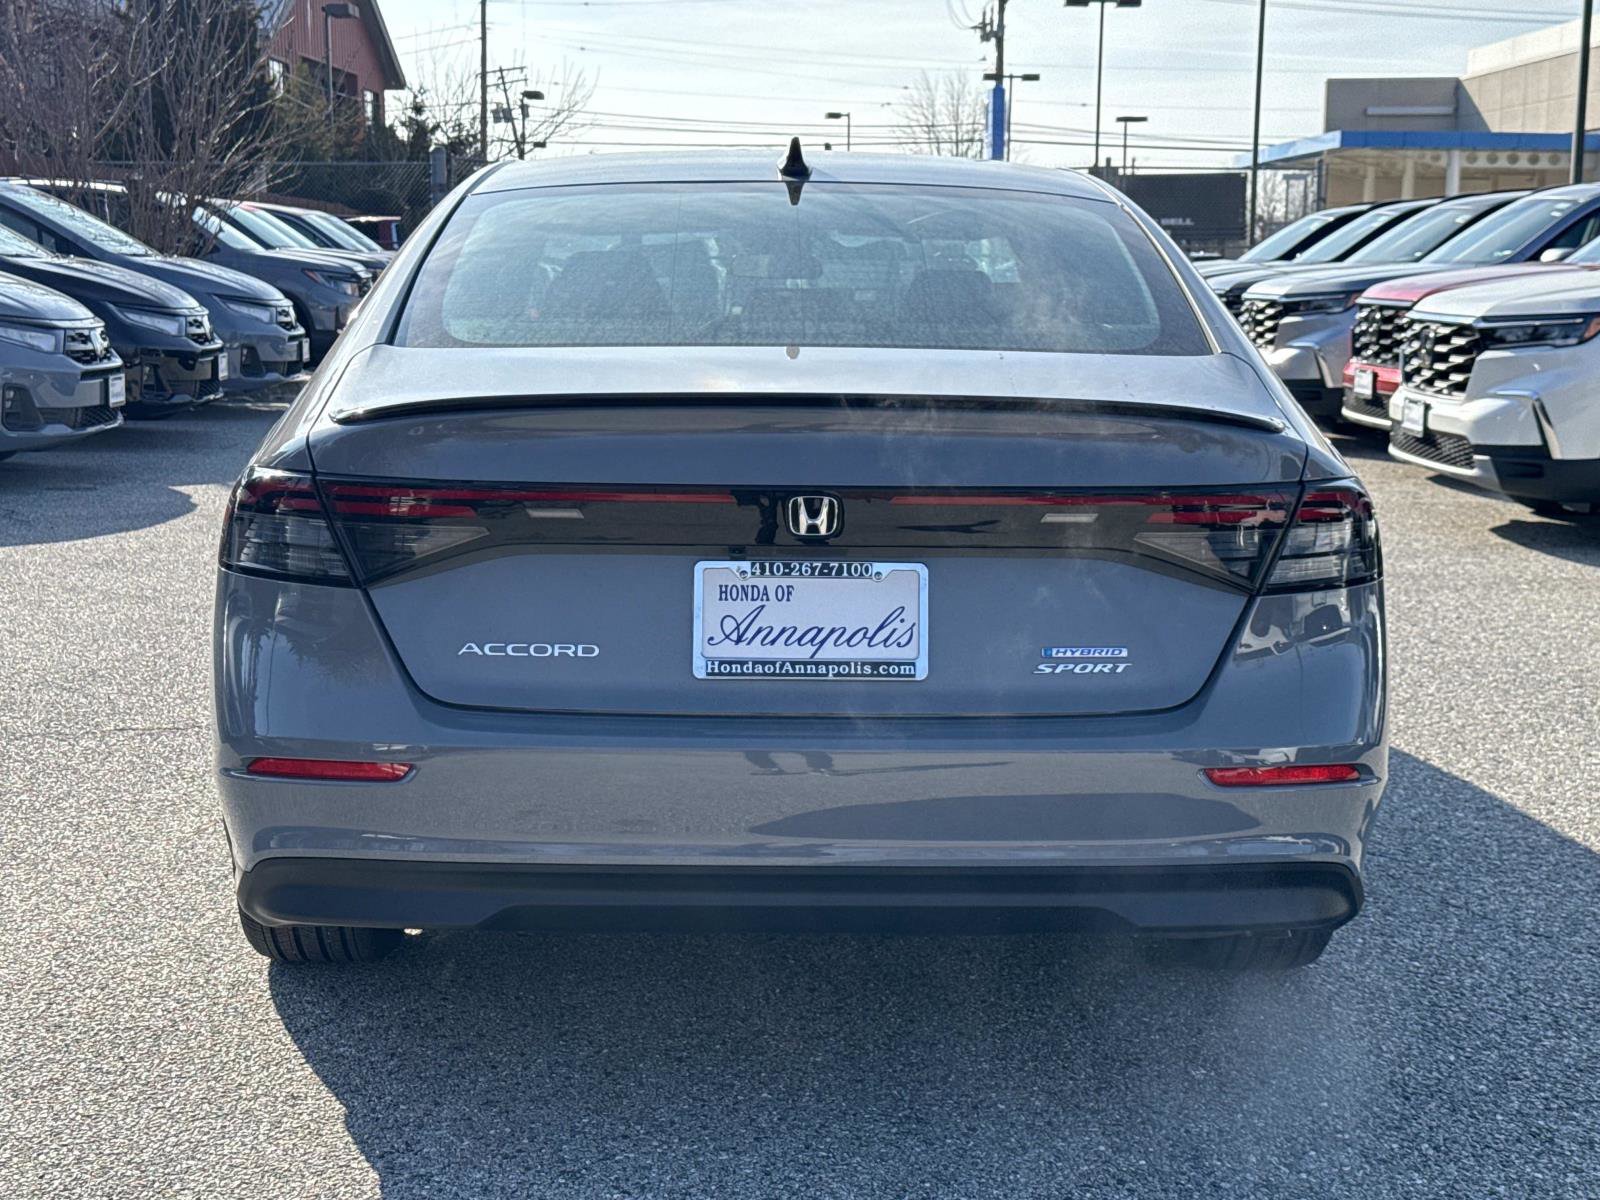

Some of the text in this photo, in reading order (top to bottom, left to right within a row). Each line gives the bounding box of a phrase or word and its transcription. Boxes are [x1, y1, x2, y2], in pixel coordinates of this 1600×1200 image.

[751, 562, 873, 577] 410-267-7100
[718, 584, 795, 601] HONDA OF
[707, 604, 917, 659] Annapolis
[457, 642, 600, 657] ACCORD
[1054, 648, 1123, 656] HYBRID
[706, 660, 916, 676] HondaofAnnapolis.com
[1033, 663, 1133, 674] SPORT
